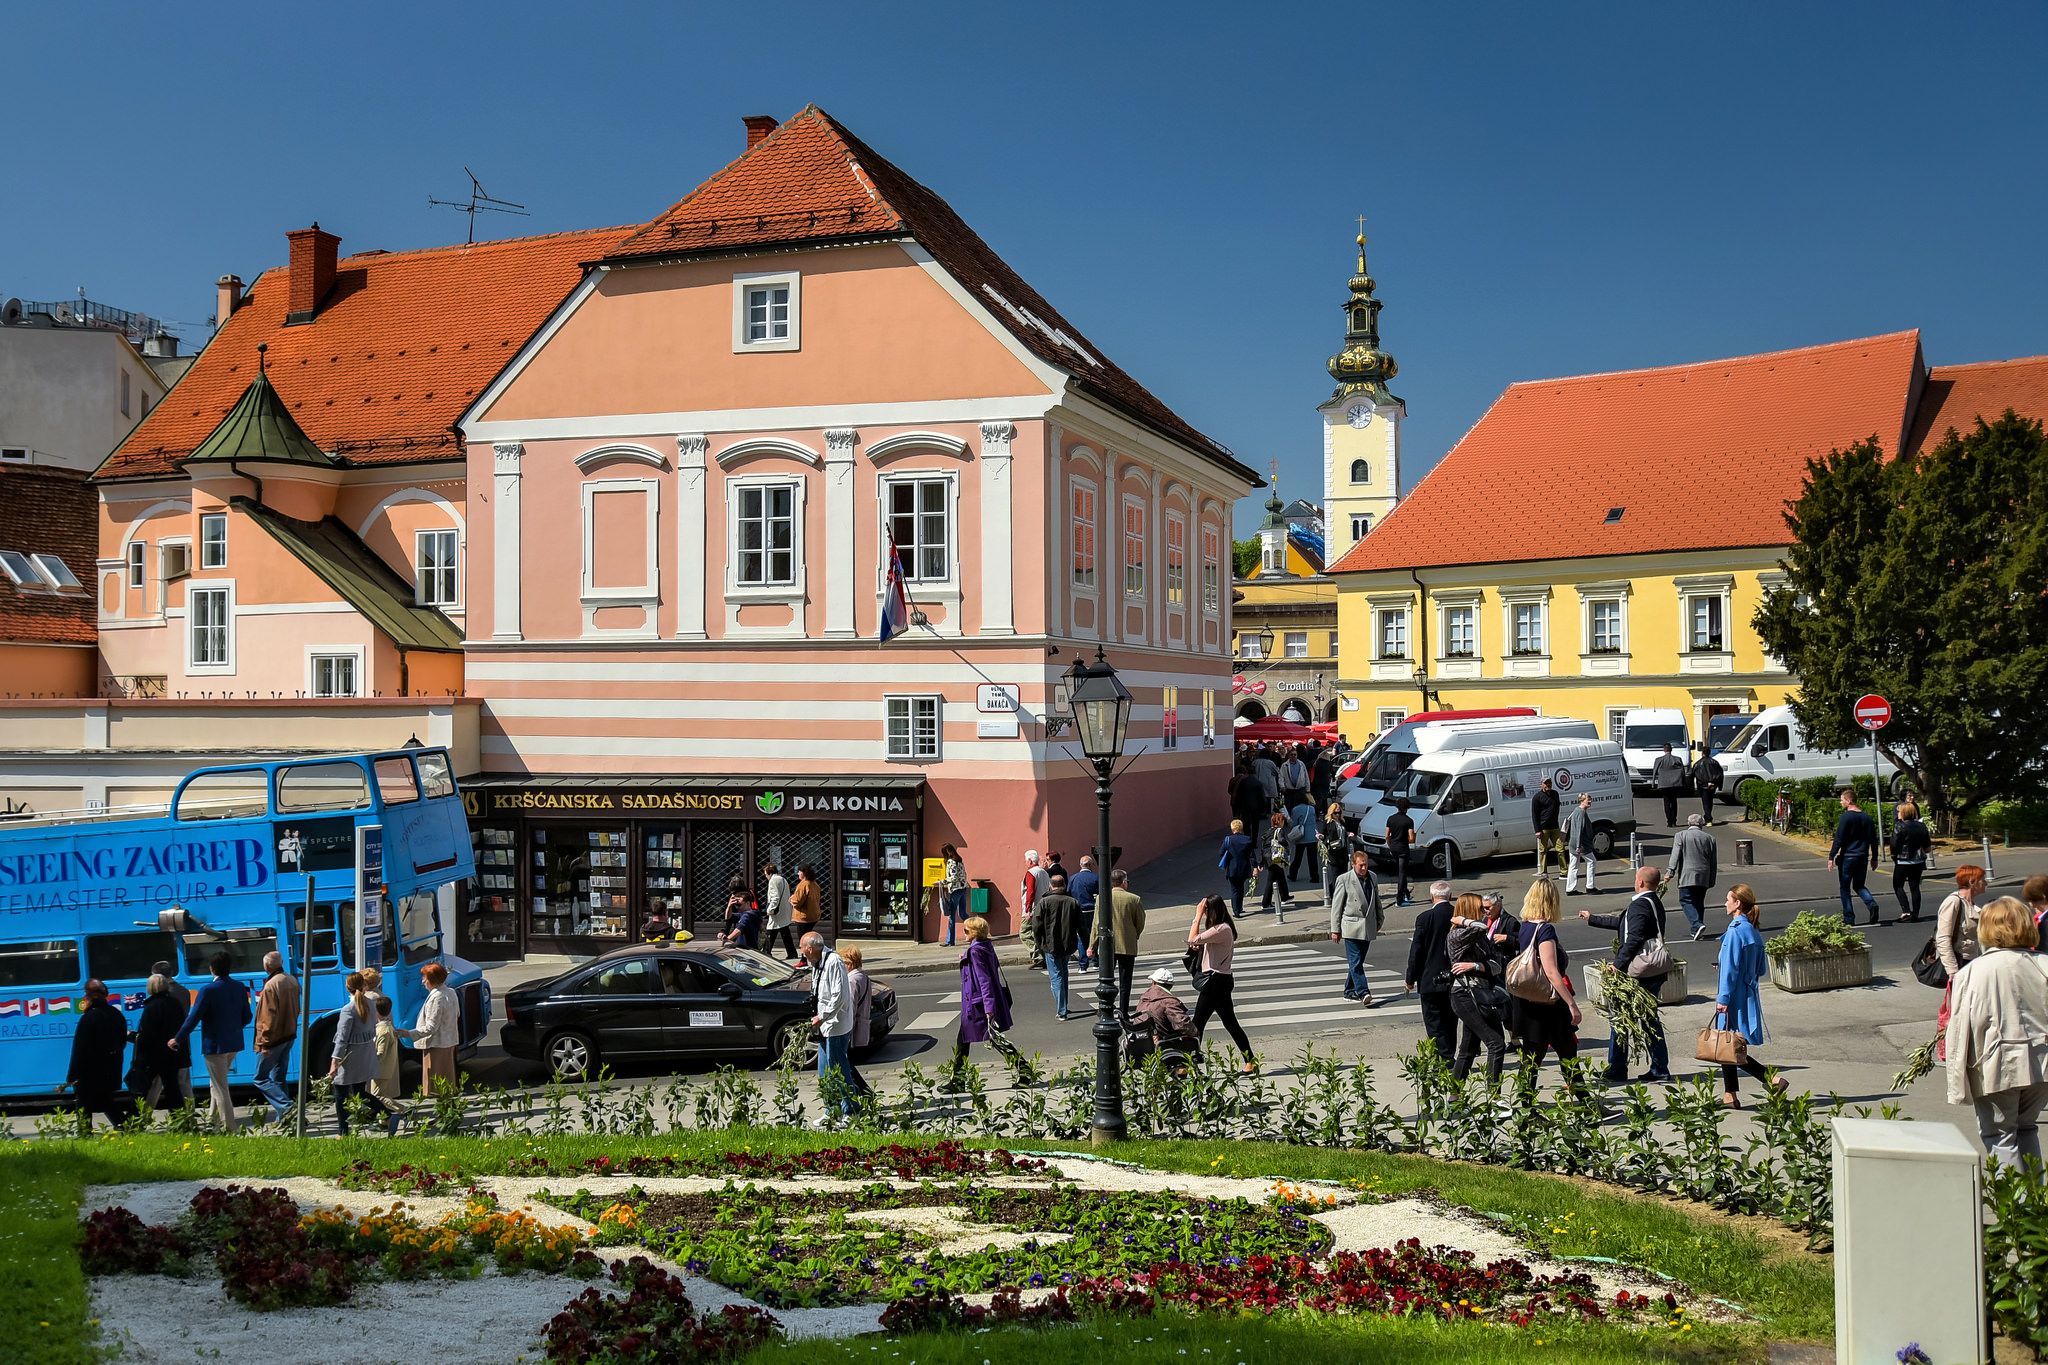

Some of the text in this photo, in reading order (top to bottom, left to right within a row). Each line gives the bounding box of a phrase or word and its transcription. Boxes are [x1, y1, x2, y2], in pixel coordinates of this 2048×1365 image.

[1277, 681, 1315, 691] Croatia
[494, 791, 744, 809] KRŠĆANSKA SADAŠNJOST
[793, 796, 904, 811] DIAKONIA
[310, 835, 352, 845] SPECTRE
[123, 838, 269, 889] ZAGREB
[140, 882, 208, 906] TOUR
[2, 1022, 68, 1037] RAZGLED
